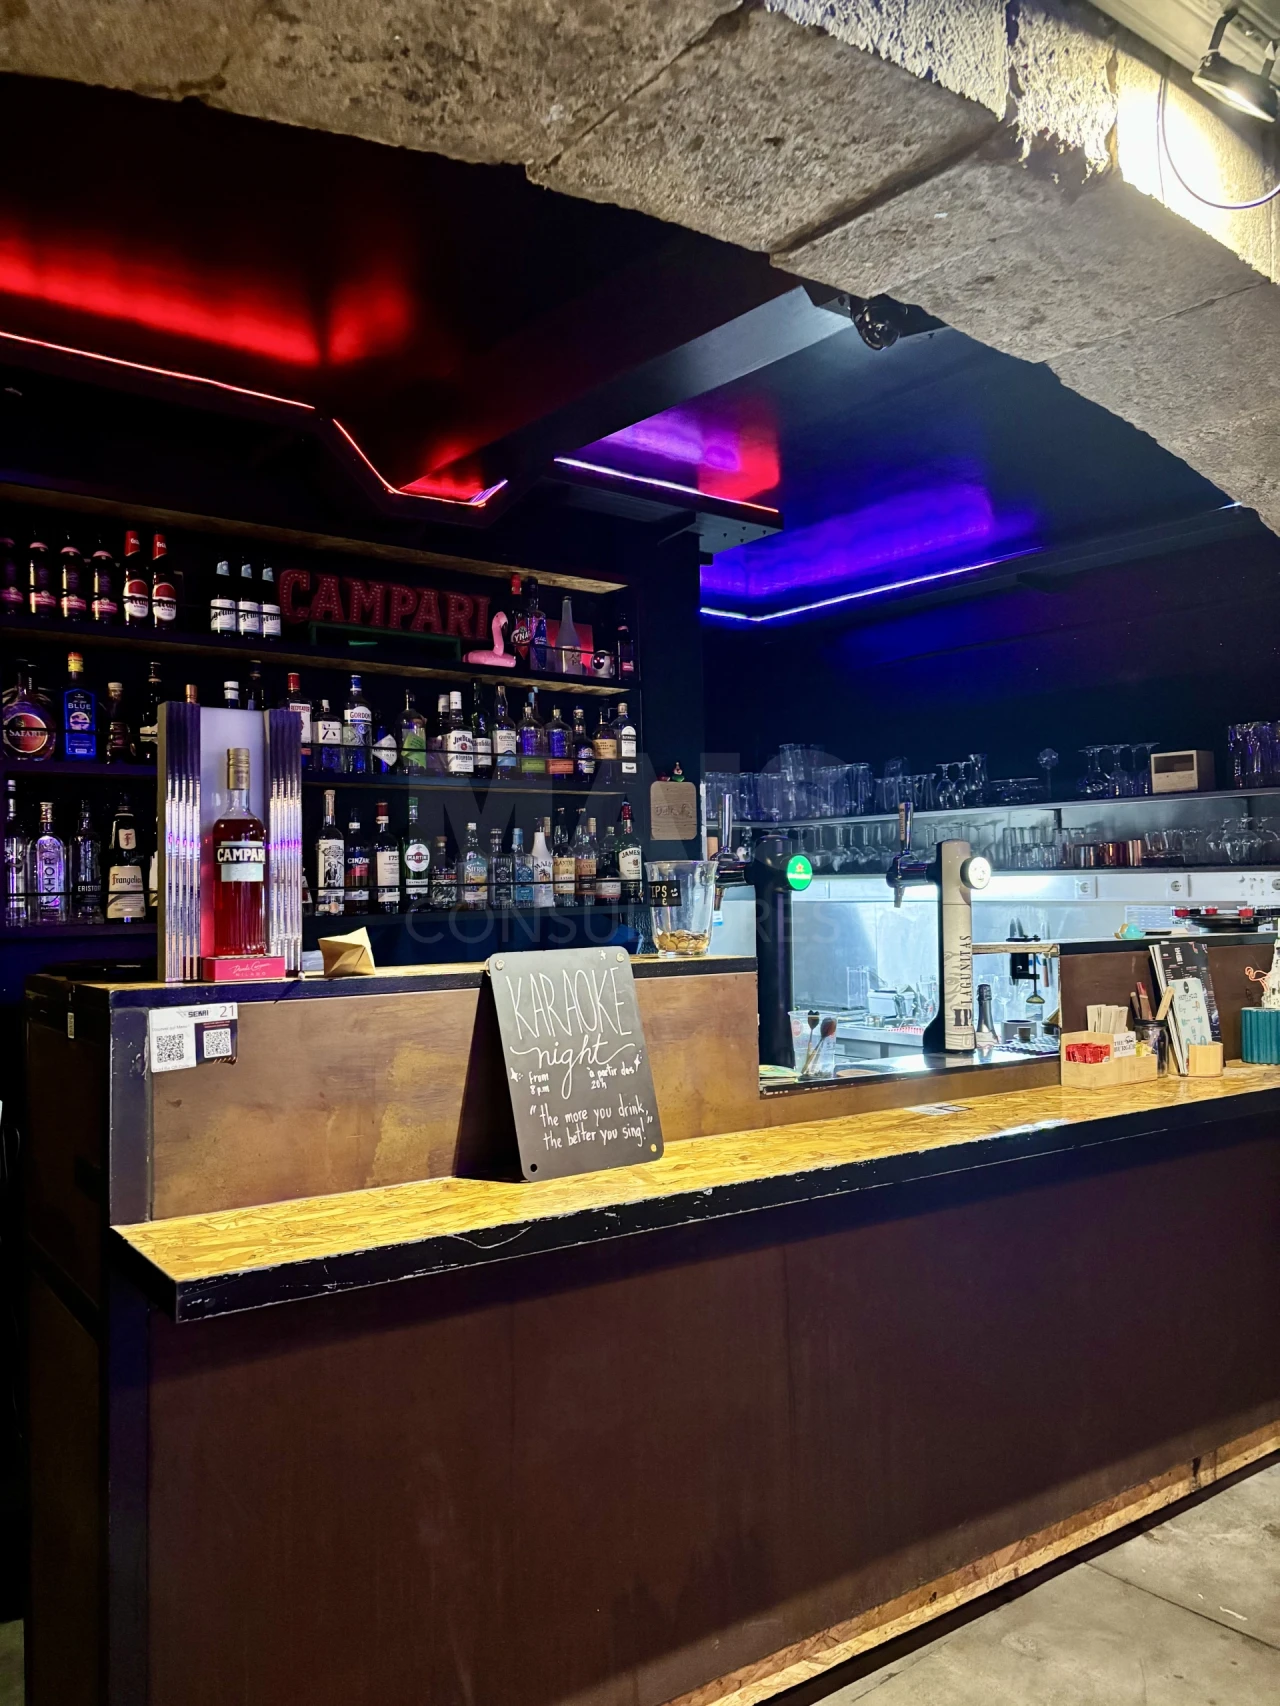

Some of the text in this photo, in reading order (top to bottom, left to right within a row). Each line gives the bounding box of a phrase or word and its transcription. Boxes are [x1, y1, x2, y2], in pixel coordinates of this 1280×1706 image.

[279, 568, 491, 641] CAMPARI
[68, 702, 92, 711] BLUE
[217, 847, 266, 862] CAMPAR
[347, 857, 371, 865] CINZAN
[466, 864, 487, 873] SIERRA
[111, 873, 143, 886] Frangelic
[650, 885, 668, 899] IPS
[959, 935, 973, 1005] LAGUNITAS
[506, 967, 632, 1040] KARAOKE
[219, 1005, 235, 1018] 21
[953, 1008, 973, 1027] IP
[510, 1034, 635, 1099] night
[597, 1064, 617, 1080] partir
[528, 1071, 550, 1085] from
[590, 1078, 607, 1090] 20h
[564, 1108, 588, 1124] more
[593, 1106, 612, 1127] you
[618, 1093, 649, 1117] drink,
[543, 1130, 563, 1151] the
[566, 1122, 597, 1147] better
[599, 1128, 618, 1146] you
